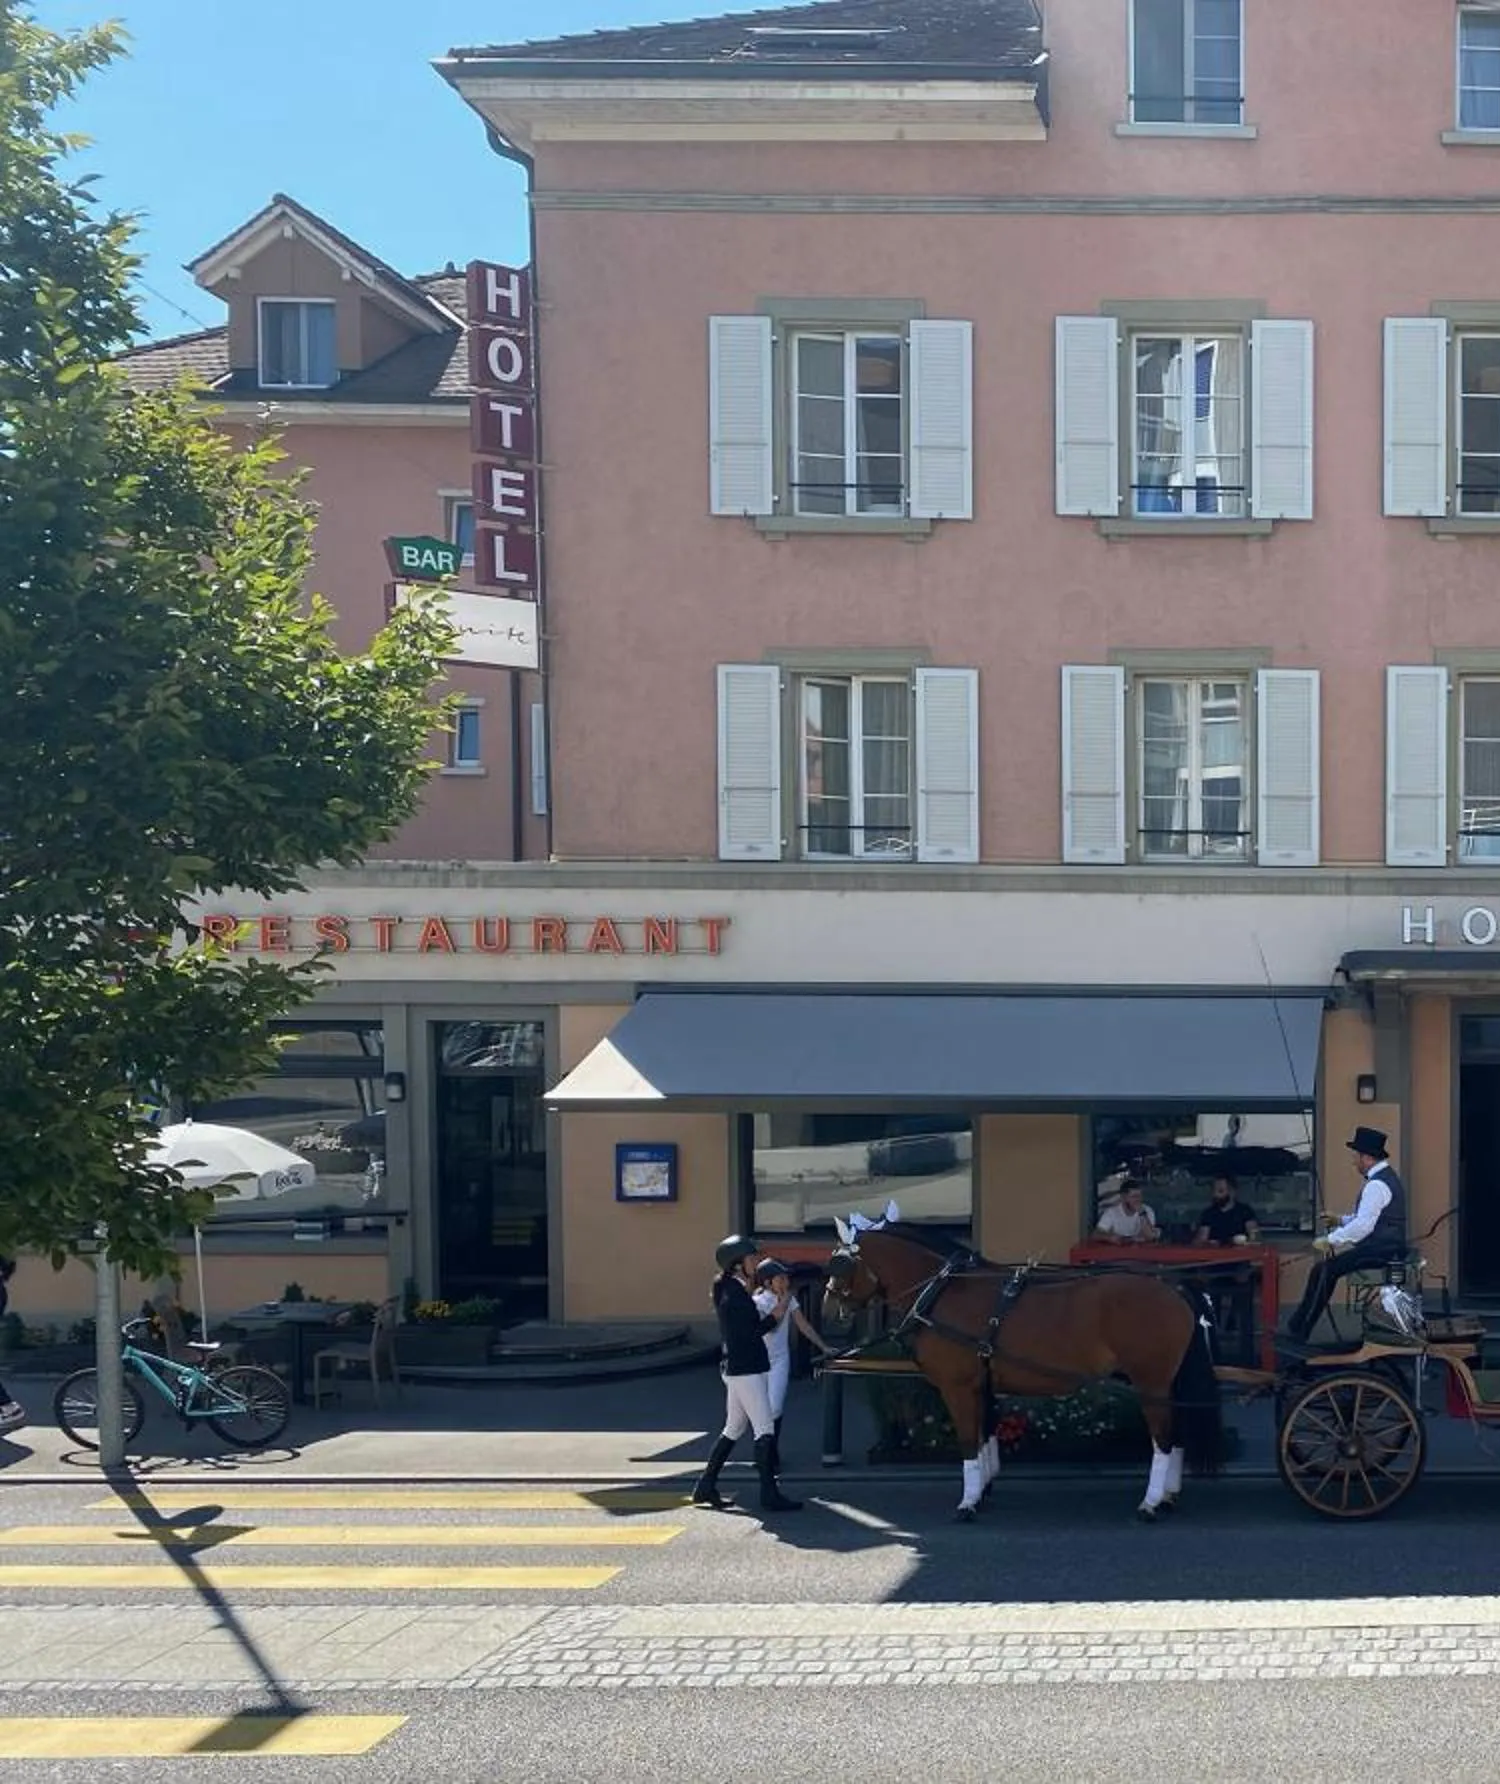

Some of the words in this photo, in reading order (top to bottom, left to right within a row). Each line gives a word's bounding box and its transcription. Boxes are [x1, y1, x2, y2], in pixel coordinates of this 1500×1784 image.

[485, 267, 529, 583] HOTEL
[401, 545, 455, 572] BAR
[202, 915, 730, 955] RESTAURANT
